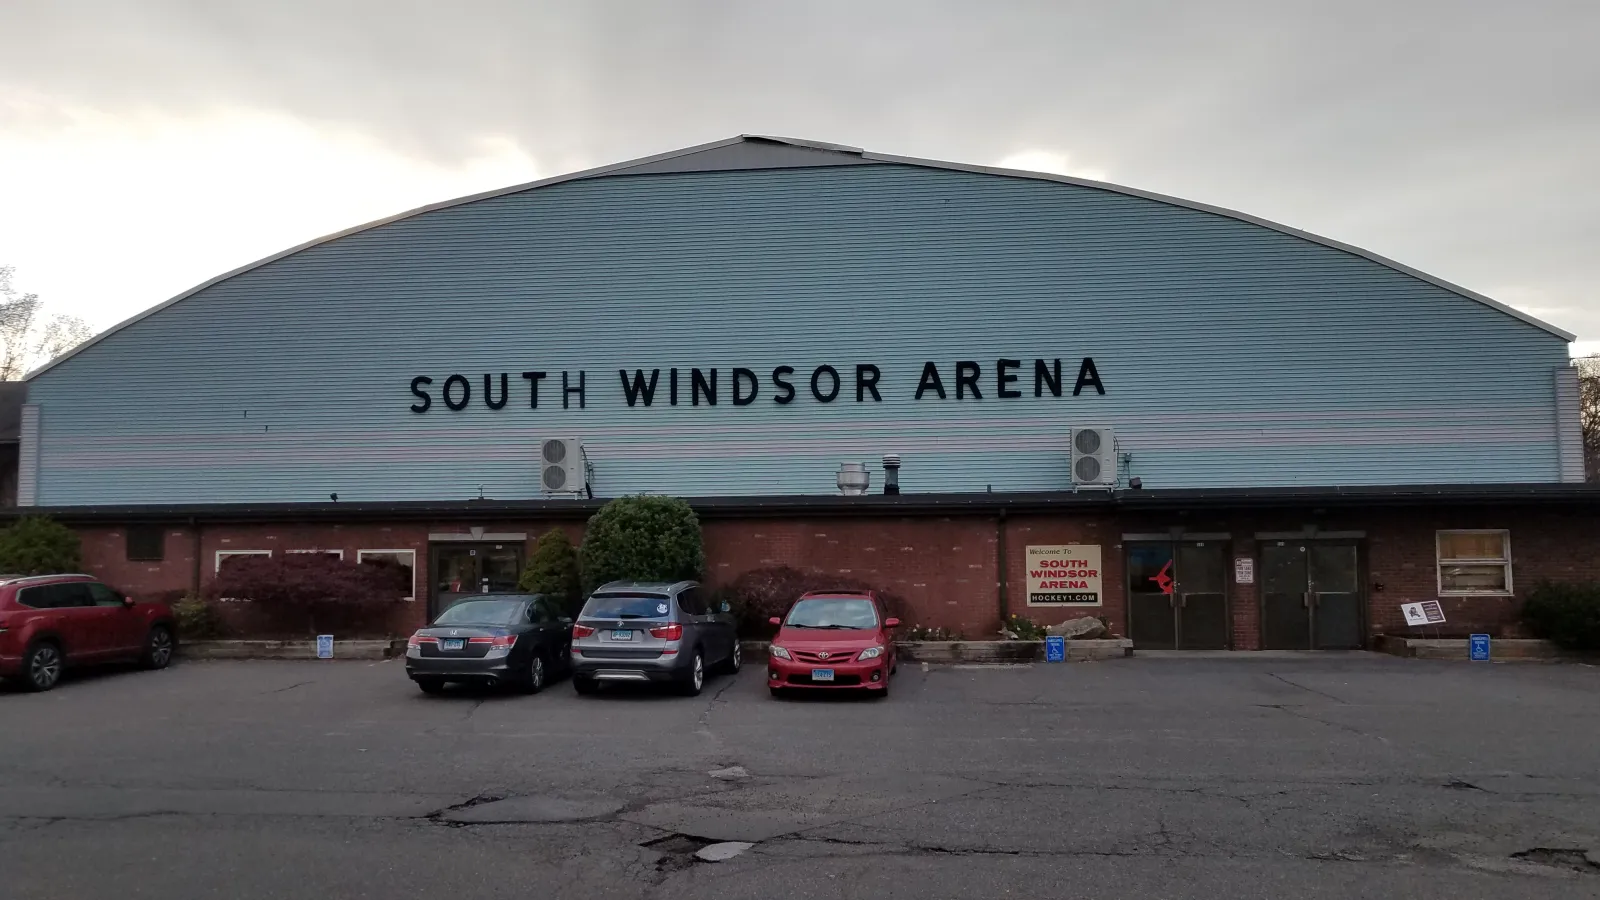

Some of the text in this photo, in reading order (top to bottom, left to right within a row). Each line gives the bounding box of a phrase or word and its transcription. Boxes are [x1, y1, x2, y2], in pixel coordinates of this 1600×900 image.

[410, 357, 1105, 413] SOUTH WINDSOR ARENA
[1040, 560, 1087, 568] SOUTH
[1030, 569, 1098, 578] WINDSOR
[1040, 581, 1088, 589] ARENA
